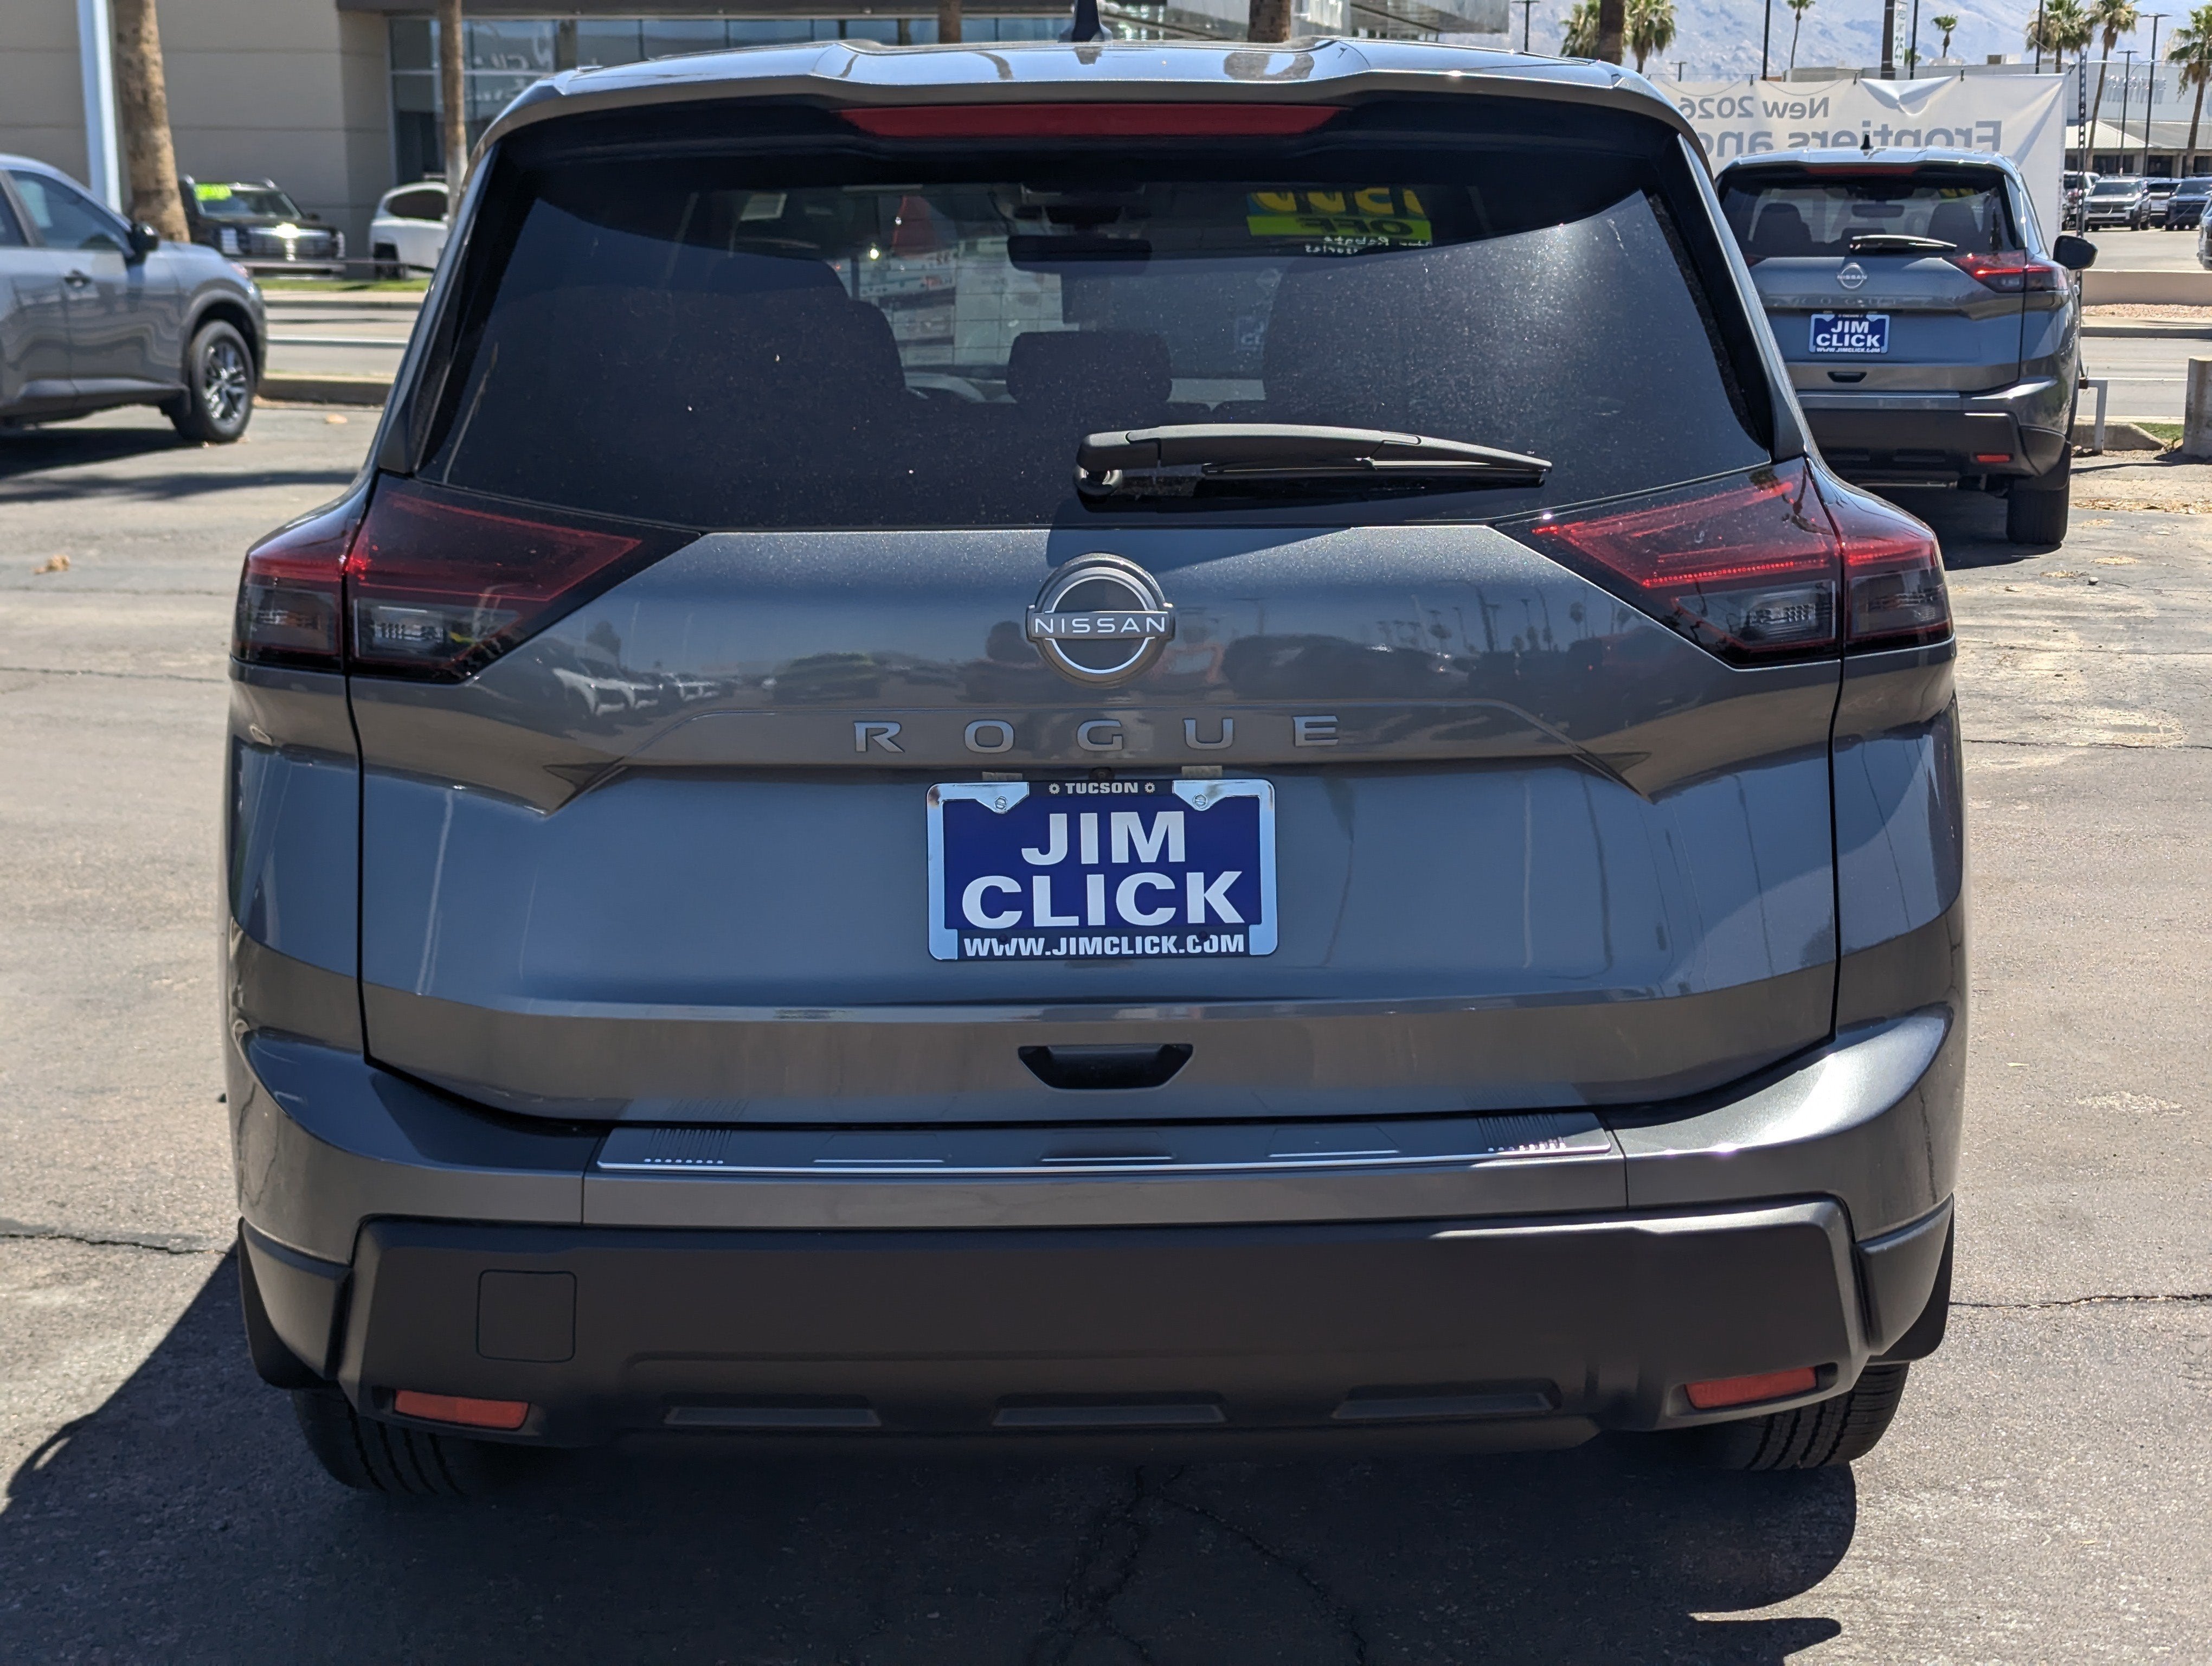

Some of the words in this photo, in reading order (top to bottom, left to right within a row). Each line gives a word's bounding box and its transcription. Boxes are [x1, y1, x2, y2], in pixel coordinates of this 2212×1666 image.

[1830, 320, 1869, 334] JIM
[1816, 334, 1881, 347] CLICK
[1034, 616, 1166, 634] NISSAN
[853, 715, 1340, 753] ROGUE
[1065, 782, 1139, 794] TUCSON
[1021, 811, 1186, 866] JIM
[962, 871, 1245, 929] CLICK
[963, 934, 1245, 957] WWW.JIMCLICK.COM
